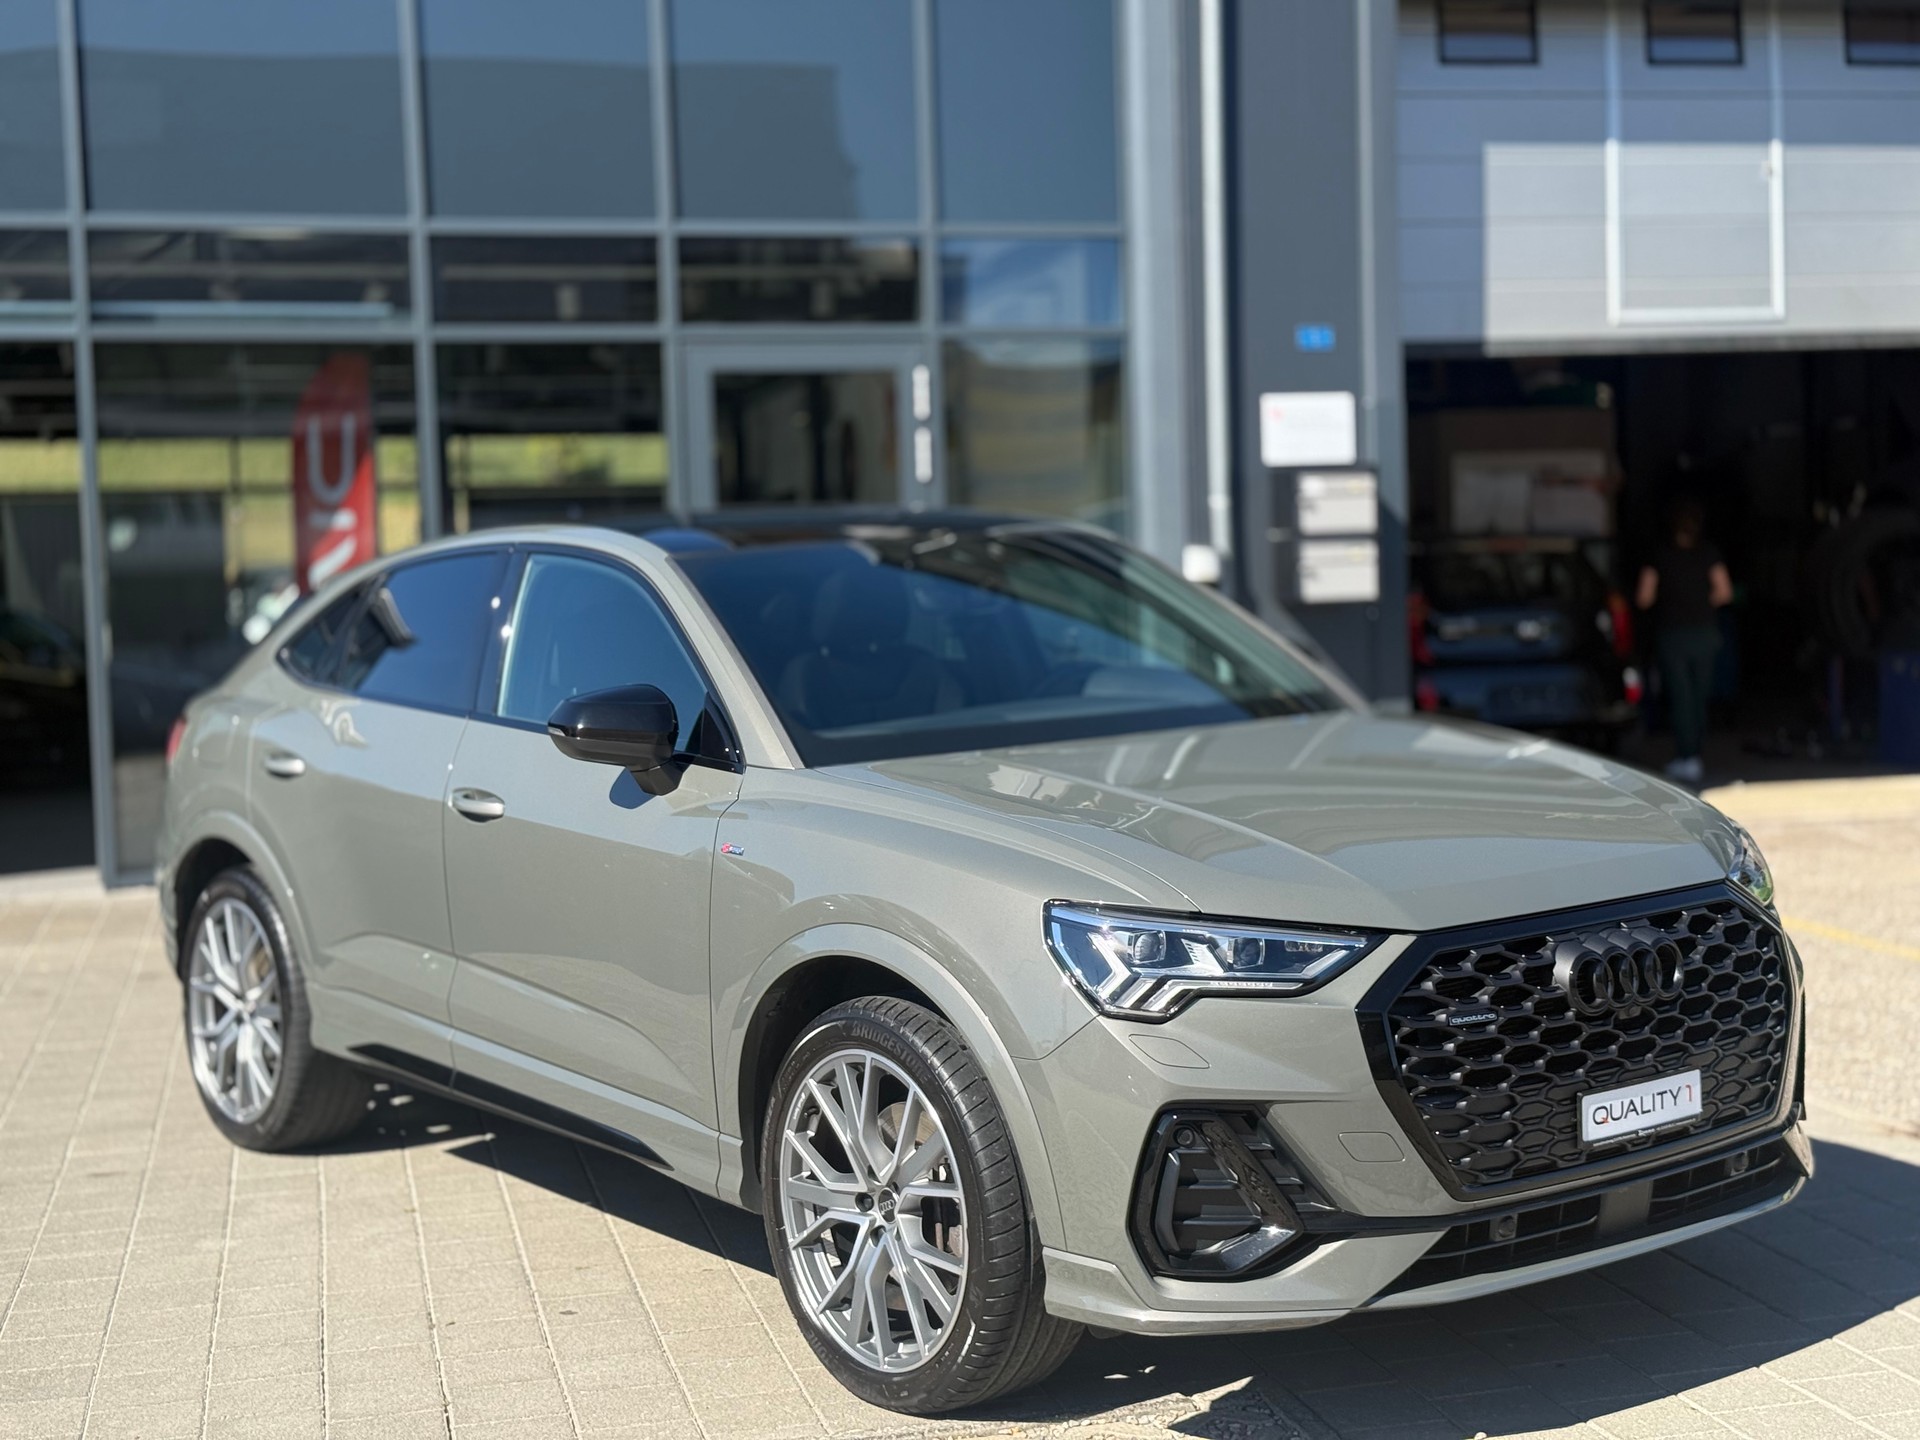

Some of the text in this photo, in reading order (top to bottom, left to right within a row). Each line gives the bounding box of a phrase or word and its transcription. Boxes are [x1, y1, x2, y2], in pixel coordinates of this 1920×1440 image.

[1451, 1013, 1496, 1025] quattro
[851, 1021, 931, 1086] BRIDGESTONE
[1592, 1084, 1693, 1125] QUALITY 1
